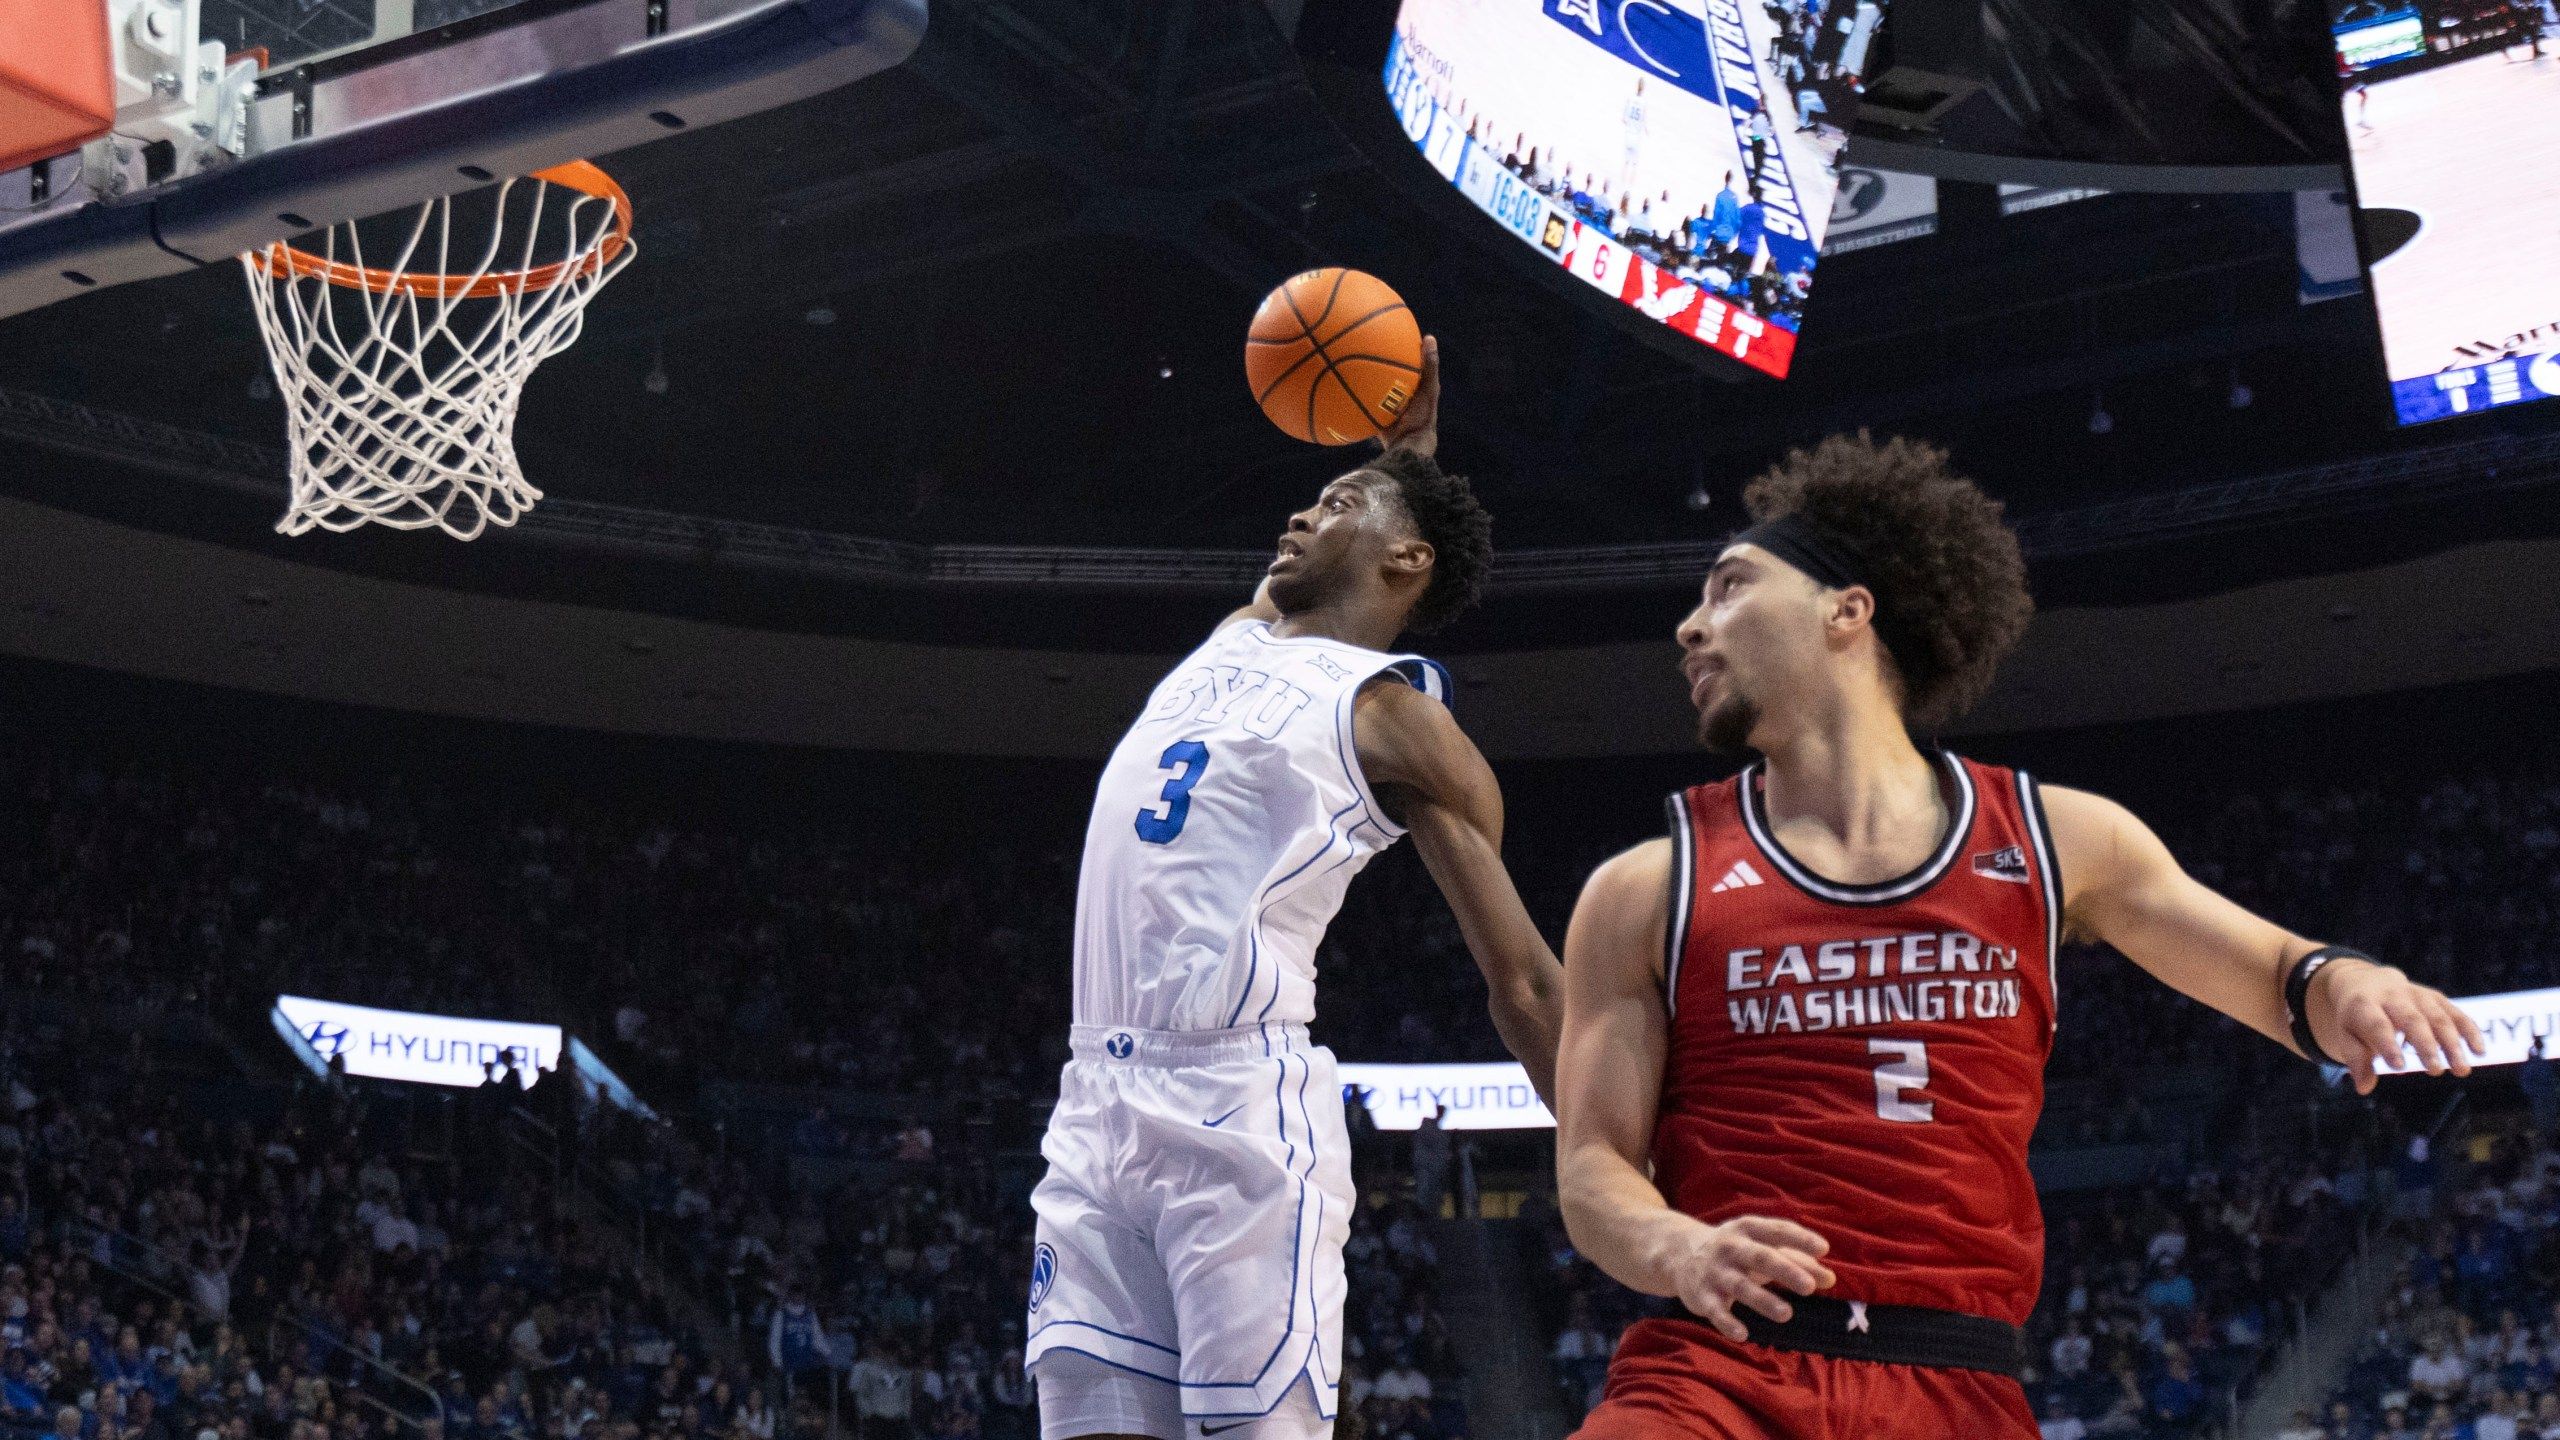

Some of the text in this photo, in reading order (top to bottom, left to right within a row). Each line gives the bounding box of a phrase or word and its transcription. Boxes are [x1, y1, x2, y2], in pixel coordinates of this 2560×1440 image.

[1706, 0, 1761, 100] GHAM
[1489, 172, 1541, 237] 16:03
[1593, 244, 1610, 280] 6
[1138, 666, 1311, 740] BYU
[1134, 740, 1210, 844] 3
[1727, 978, 2020, 1034] WASHINGTON
[2481, 1013, 2560, 1043] HYU
[1399, 1085, 1541, 1111] HYUND
[1868, 1039, 1934, 1123] 2
